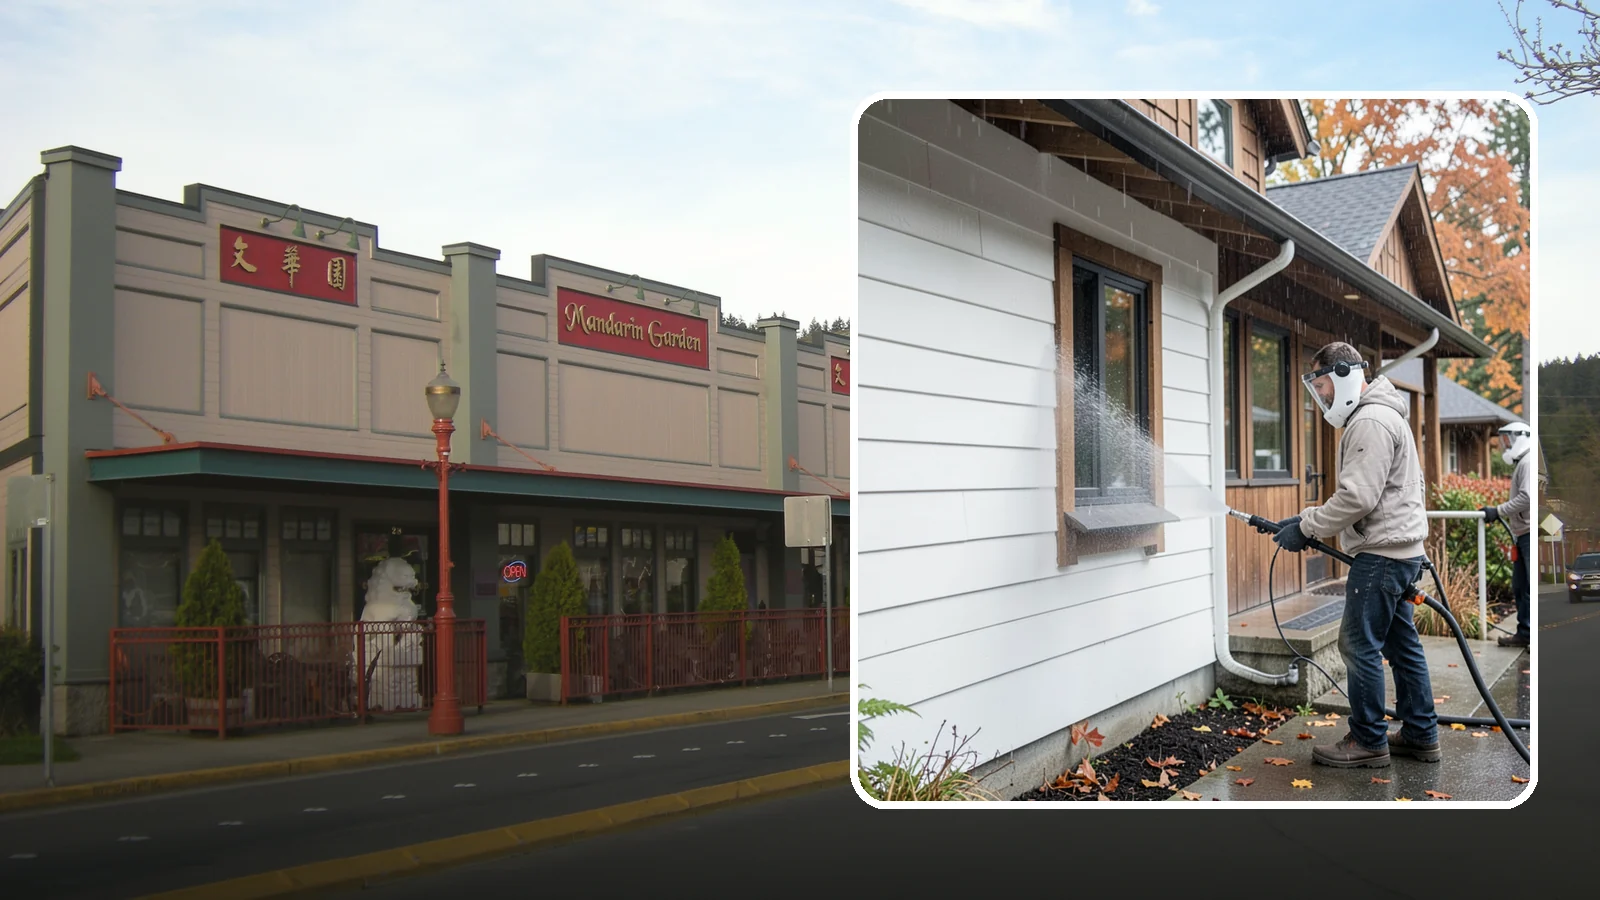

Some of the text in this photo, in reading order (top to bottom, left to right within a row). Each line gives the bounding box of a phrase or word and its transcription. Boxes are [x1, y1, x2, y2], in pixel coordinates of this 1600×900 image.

[565, 302, 701, 352] Mandarin Garden
[503, 565, 526, 578] OPEN
